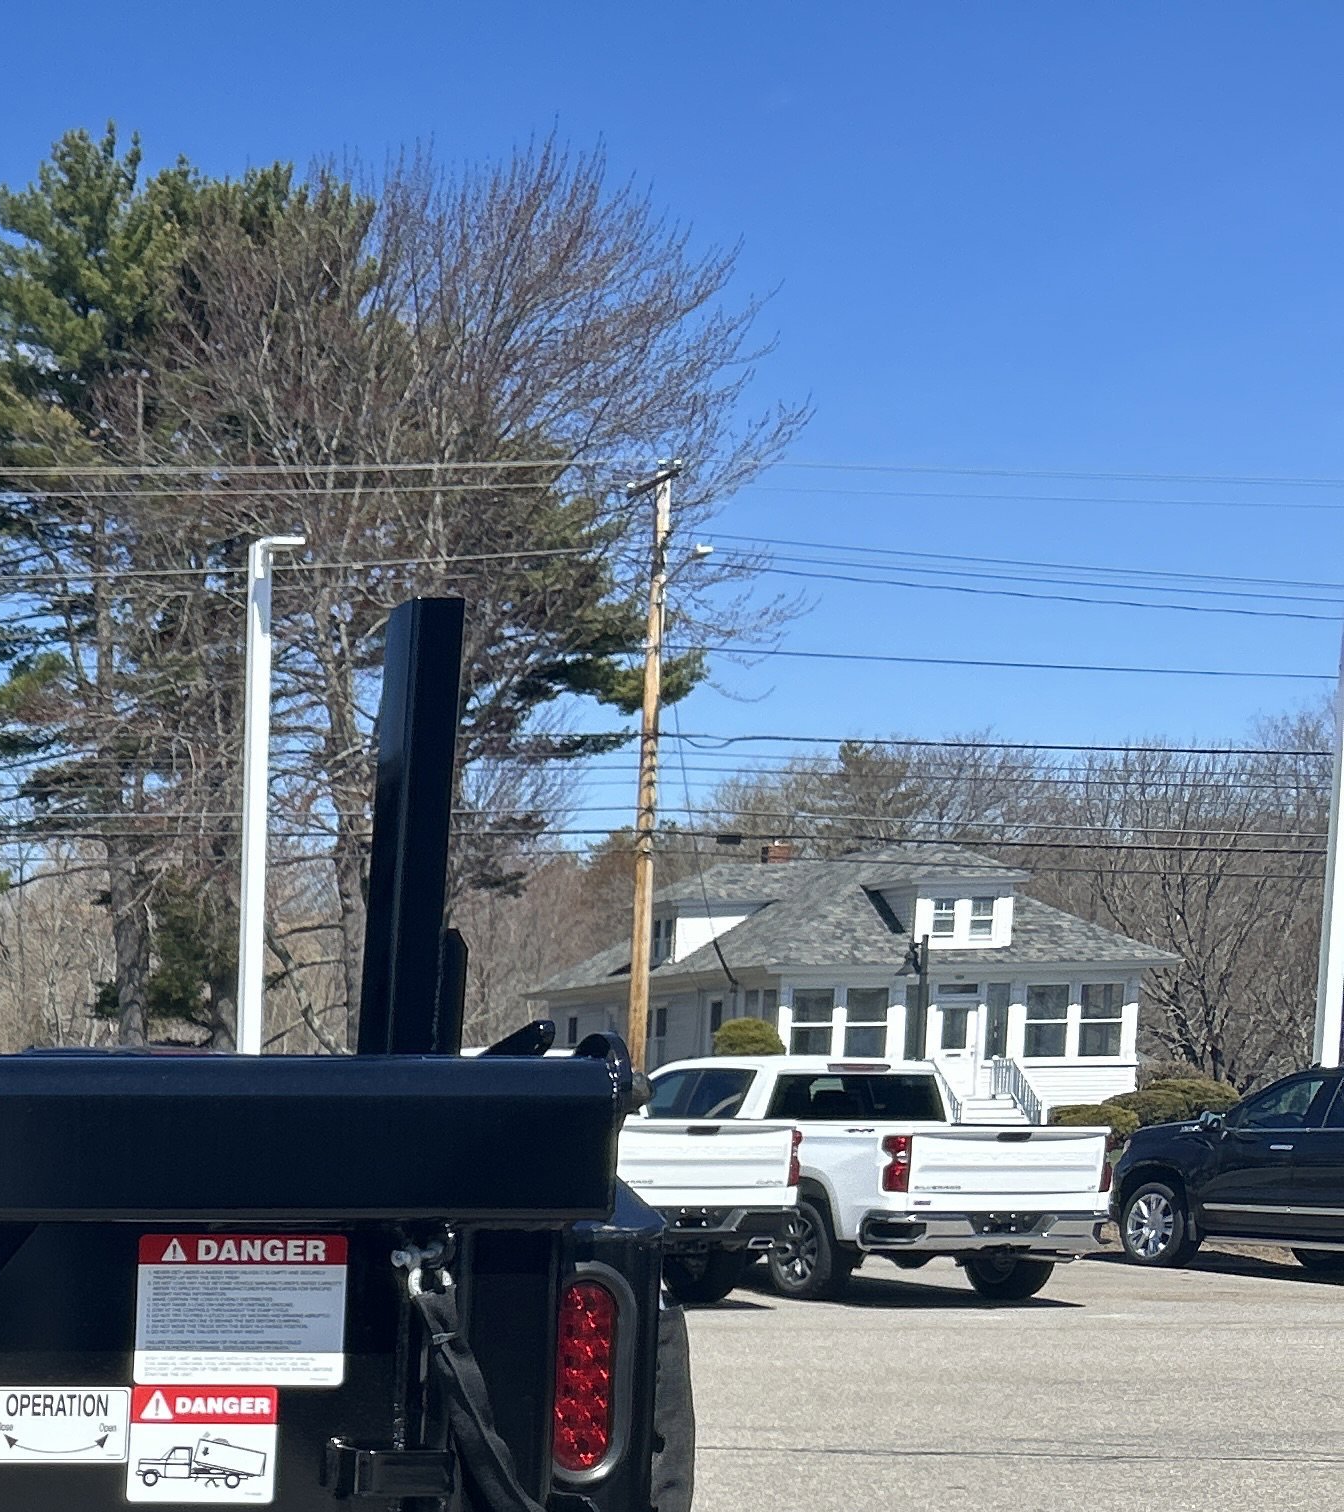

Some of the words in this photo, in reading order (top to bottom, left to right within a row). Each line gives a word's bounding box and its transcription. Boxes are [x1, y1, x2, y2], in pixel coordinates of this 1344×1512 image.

[197, 1239, 326, 1261] DANGER
[6, 1393, 109, 1417] OPERATION
[175, 1396, 271, 1415] DANGER
[99, 1423, 117, 1433] Open
